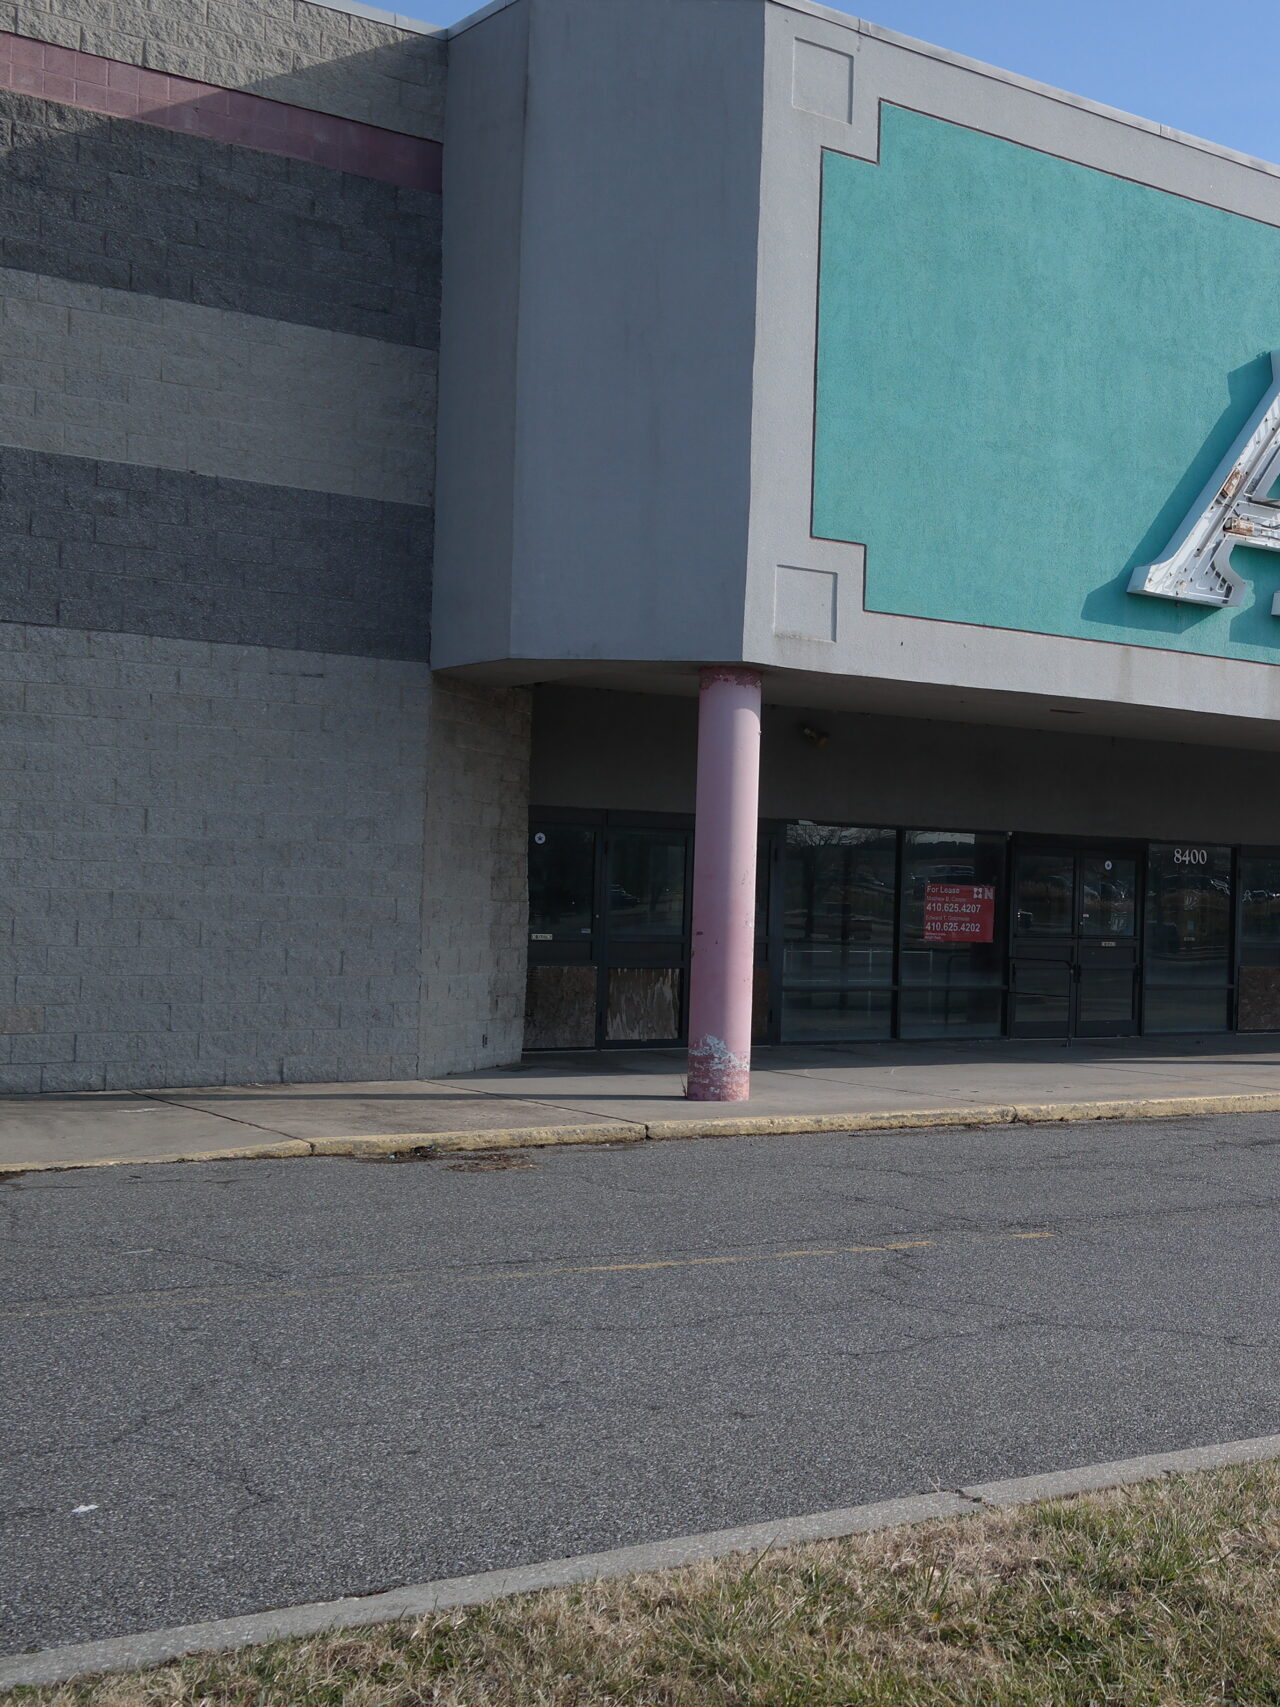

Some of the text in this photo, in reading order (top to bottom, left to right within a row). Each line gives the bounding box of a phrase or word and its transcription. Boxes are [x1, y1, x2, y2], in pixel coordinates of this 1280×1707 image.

[1173, 848, 1208, 865] 8400
[940, 886, 960, 894] Lease
[926, 902, 981, 913] 410.625.4207
[925, 922, 981, 932] 410.625.4202
